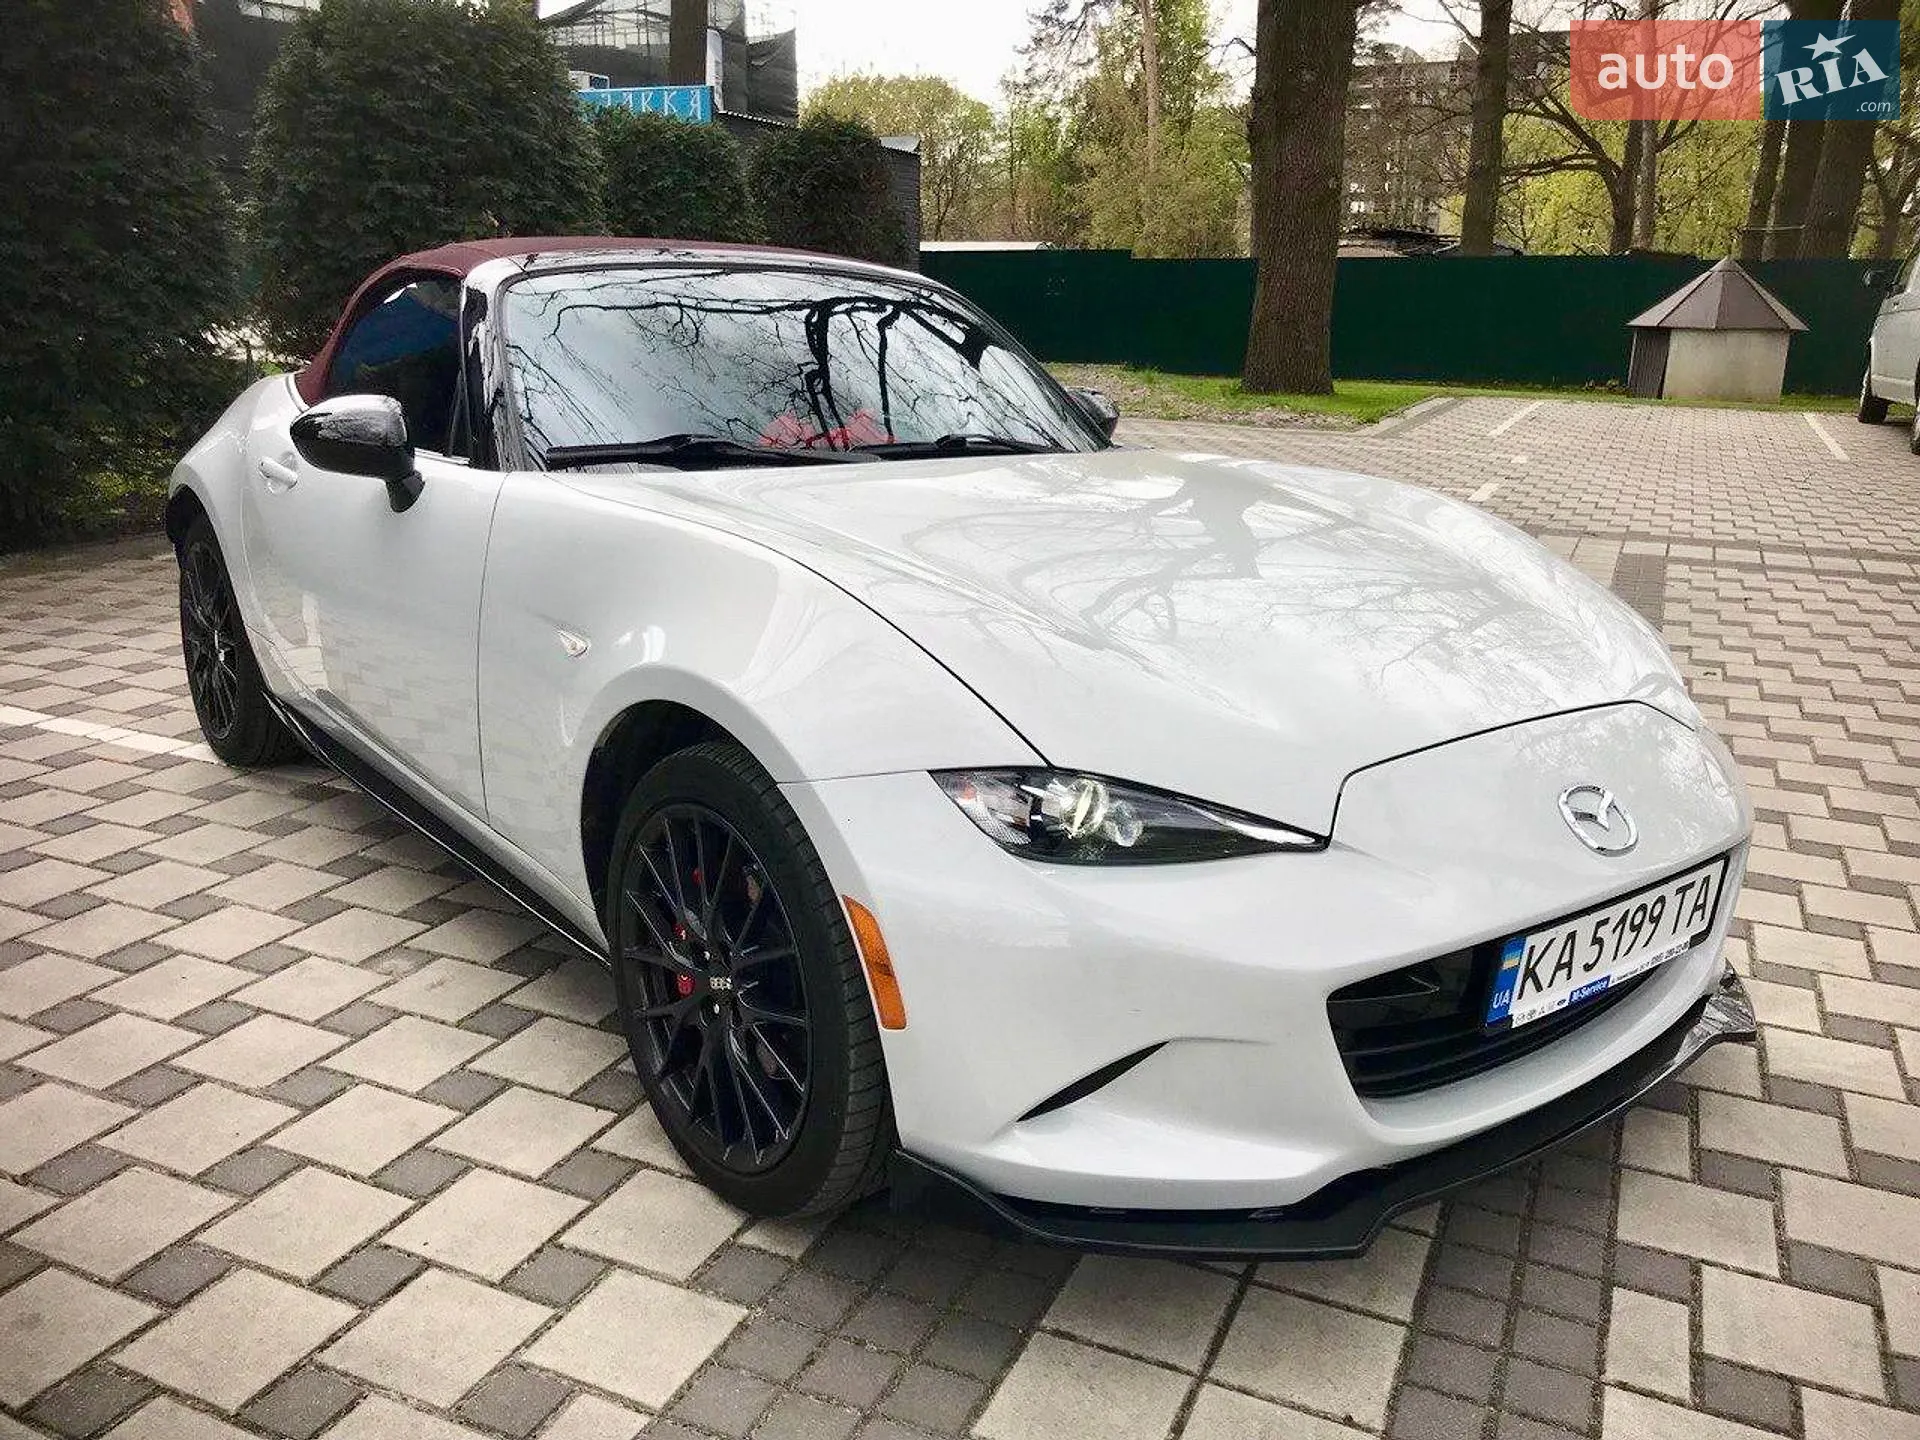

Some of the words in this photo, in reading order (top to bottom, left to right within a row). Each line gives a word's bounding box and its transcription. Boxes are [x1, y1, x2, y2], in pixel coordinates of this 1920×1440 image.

[1517, 929, 1578, 1000] KA
[1583, 894, 1667, 973] 5199
[1671, 874, 1712, 936] TA
[1492, 990, 1511, 1009] UA
